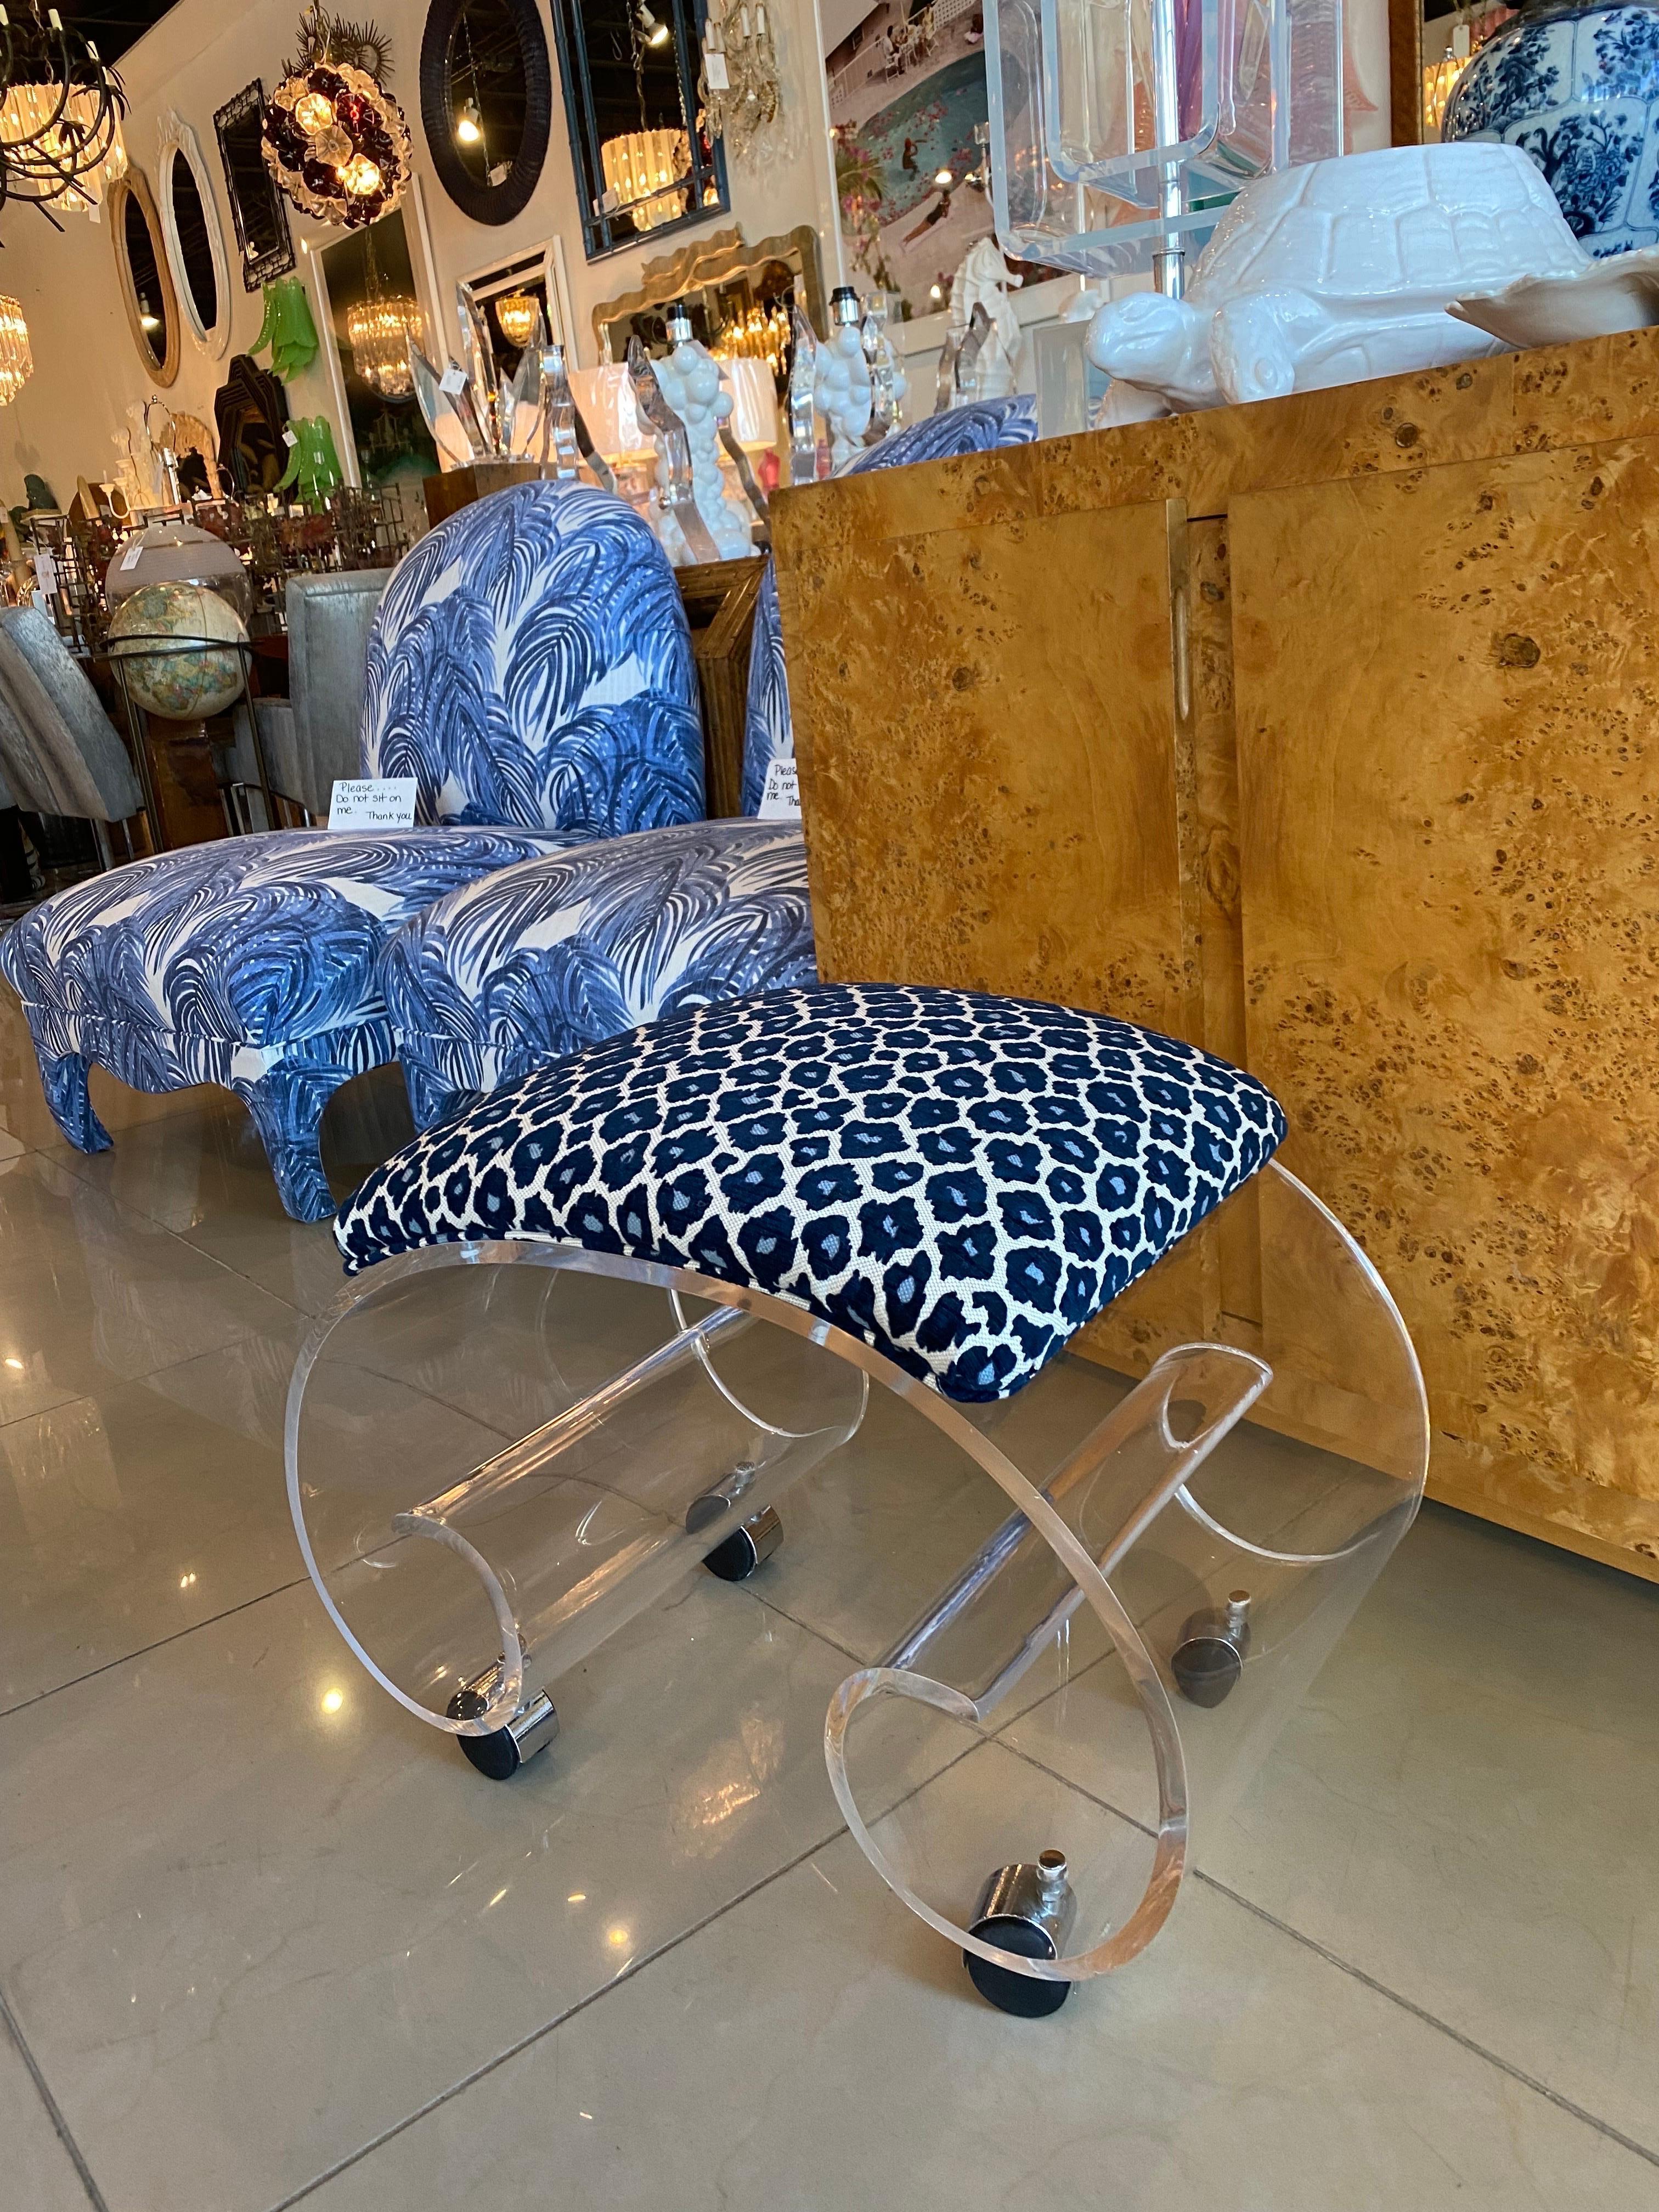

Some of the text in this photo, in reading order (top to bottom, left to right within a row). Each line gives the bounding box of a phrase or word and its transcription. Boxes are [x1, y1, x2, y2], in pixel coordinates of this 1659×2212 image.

[775, 764, 797, 776] Pleas
[769, 778, 797, 790] Do not
[336, 794, 349, 803] Do
[353, 794, 369, 803] not
[373, 793, 387, 802] sit
[786, 796, 800, 806] Tha
[365, 811, 412, 823] Thank you
